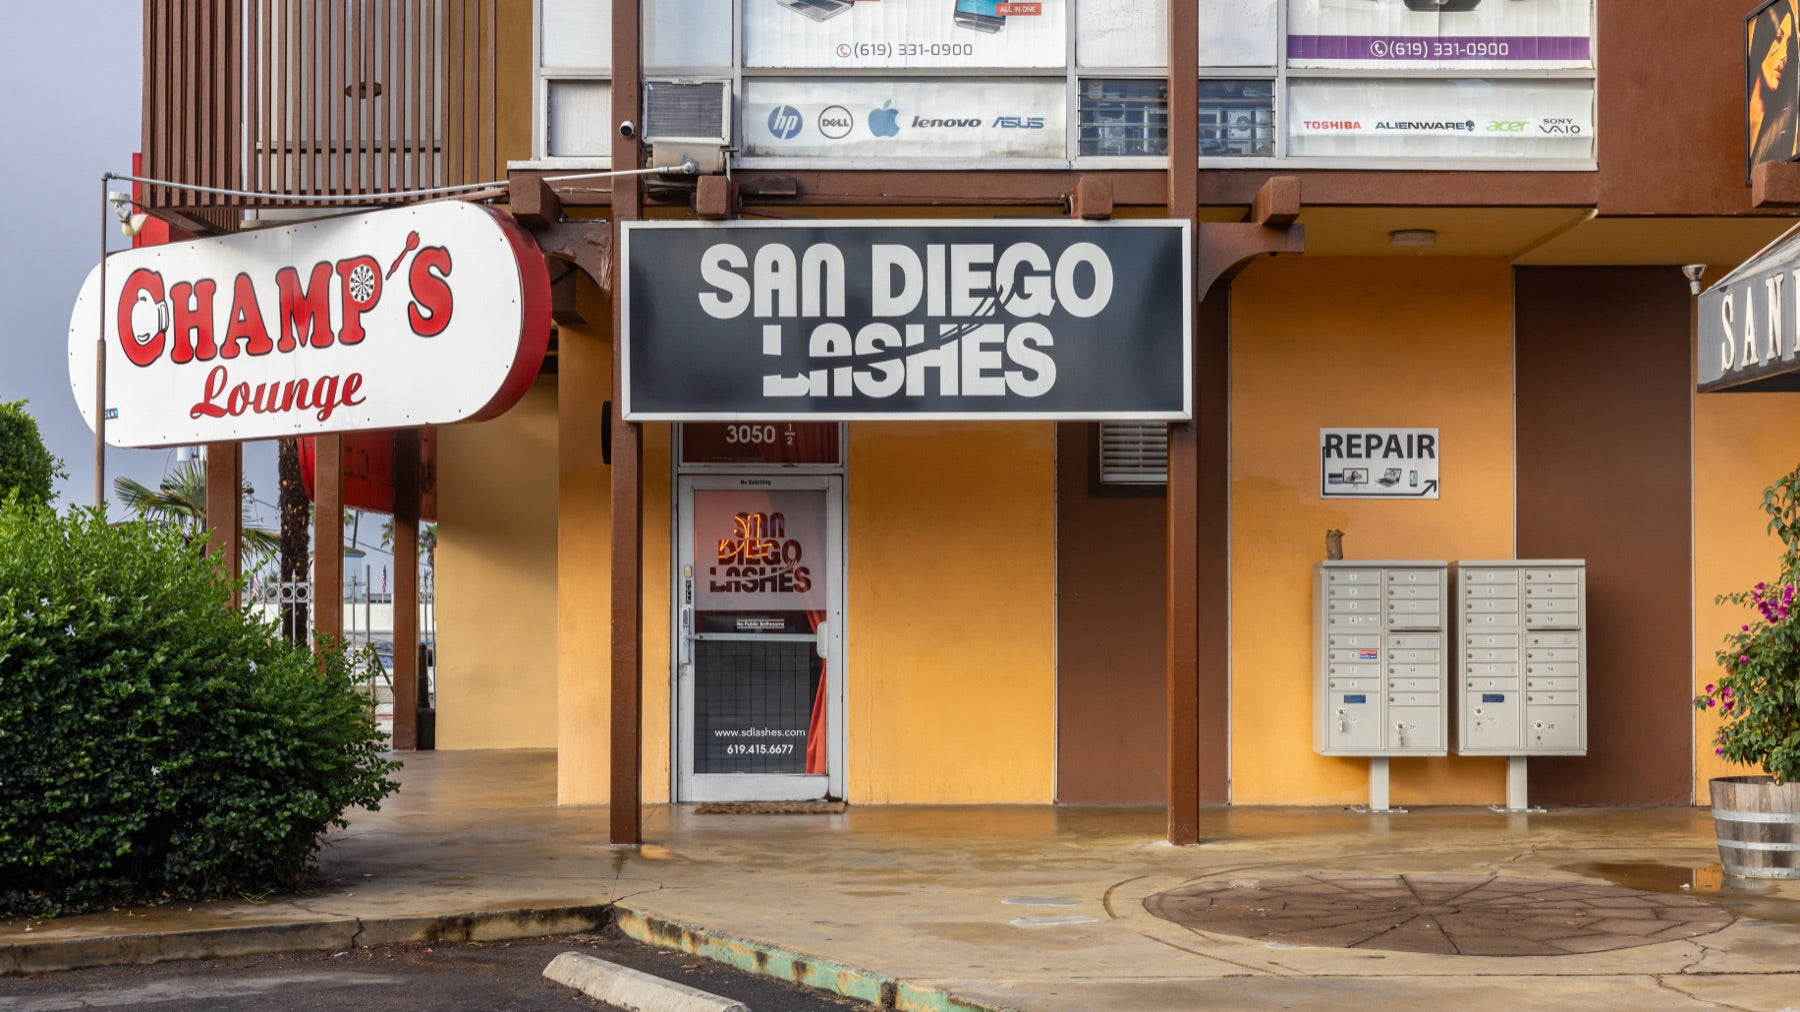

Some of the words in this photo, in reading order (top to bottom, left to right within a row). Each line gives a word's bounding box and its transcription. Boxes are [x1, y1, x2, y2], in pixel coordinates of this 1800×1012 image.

[999, 5, 1012, 13] ALL
[1013, 5, 1020, 13] IN
[1022, 5, 1036, 13] ONE
[854, 42, 893, 58] (619)
[898, 43, 973, 56] 331-0900
[1388, 40, 1429, 58] (619)
[1433, 42, 1509, 56] 331-0900
[772, 106, 799, 139] hp
[911, 115, 982, 128] lenovo
[991, 116, 1044, 129] ASUS
[1303, 120, 1362, 130] TOSHIBA
[1375, 121, 1465, 130] ALIENWARE
[1485, 120, 1530, 132] acer
[1538, 125, 1580, 134] VAIO
[698, 242, 846, 319] SAN
[871, 241, 1114, 319] DIEGO
[117, 230, 454, 367] CHAMP'S
[762, 321, 1057, 399] LASHES
[189, 365, 367, 422] Lounge
[725, 424, 776, 444] 3050
[1325, 433, 1436, 459] REPAIR
[718, 539, 802, 566] DIEGO
[709, 566, 812, 593] LASHES
[714, 727, 806, 737] www.sdlashes.com
[726, 744, 794, 755] 619.415.6677
